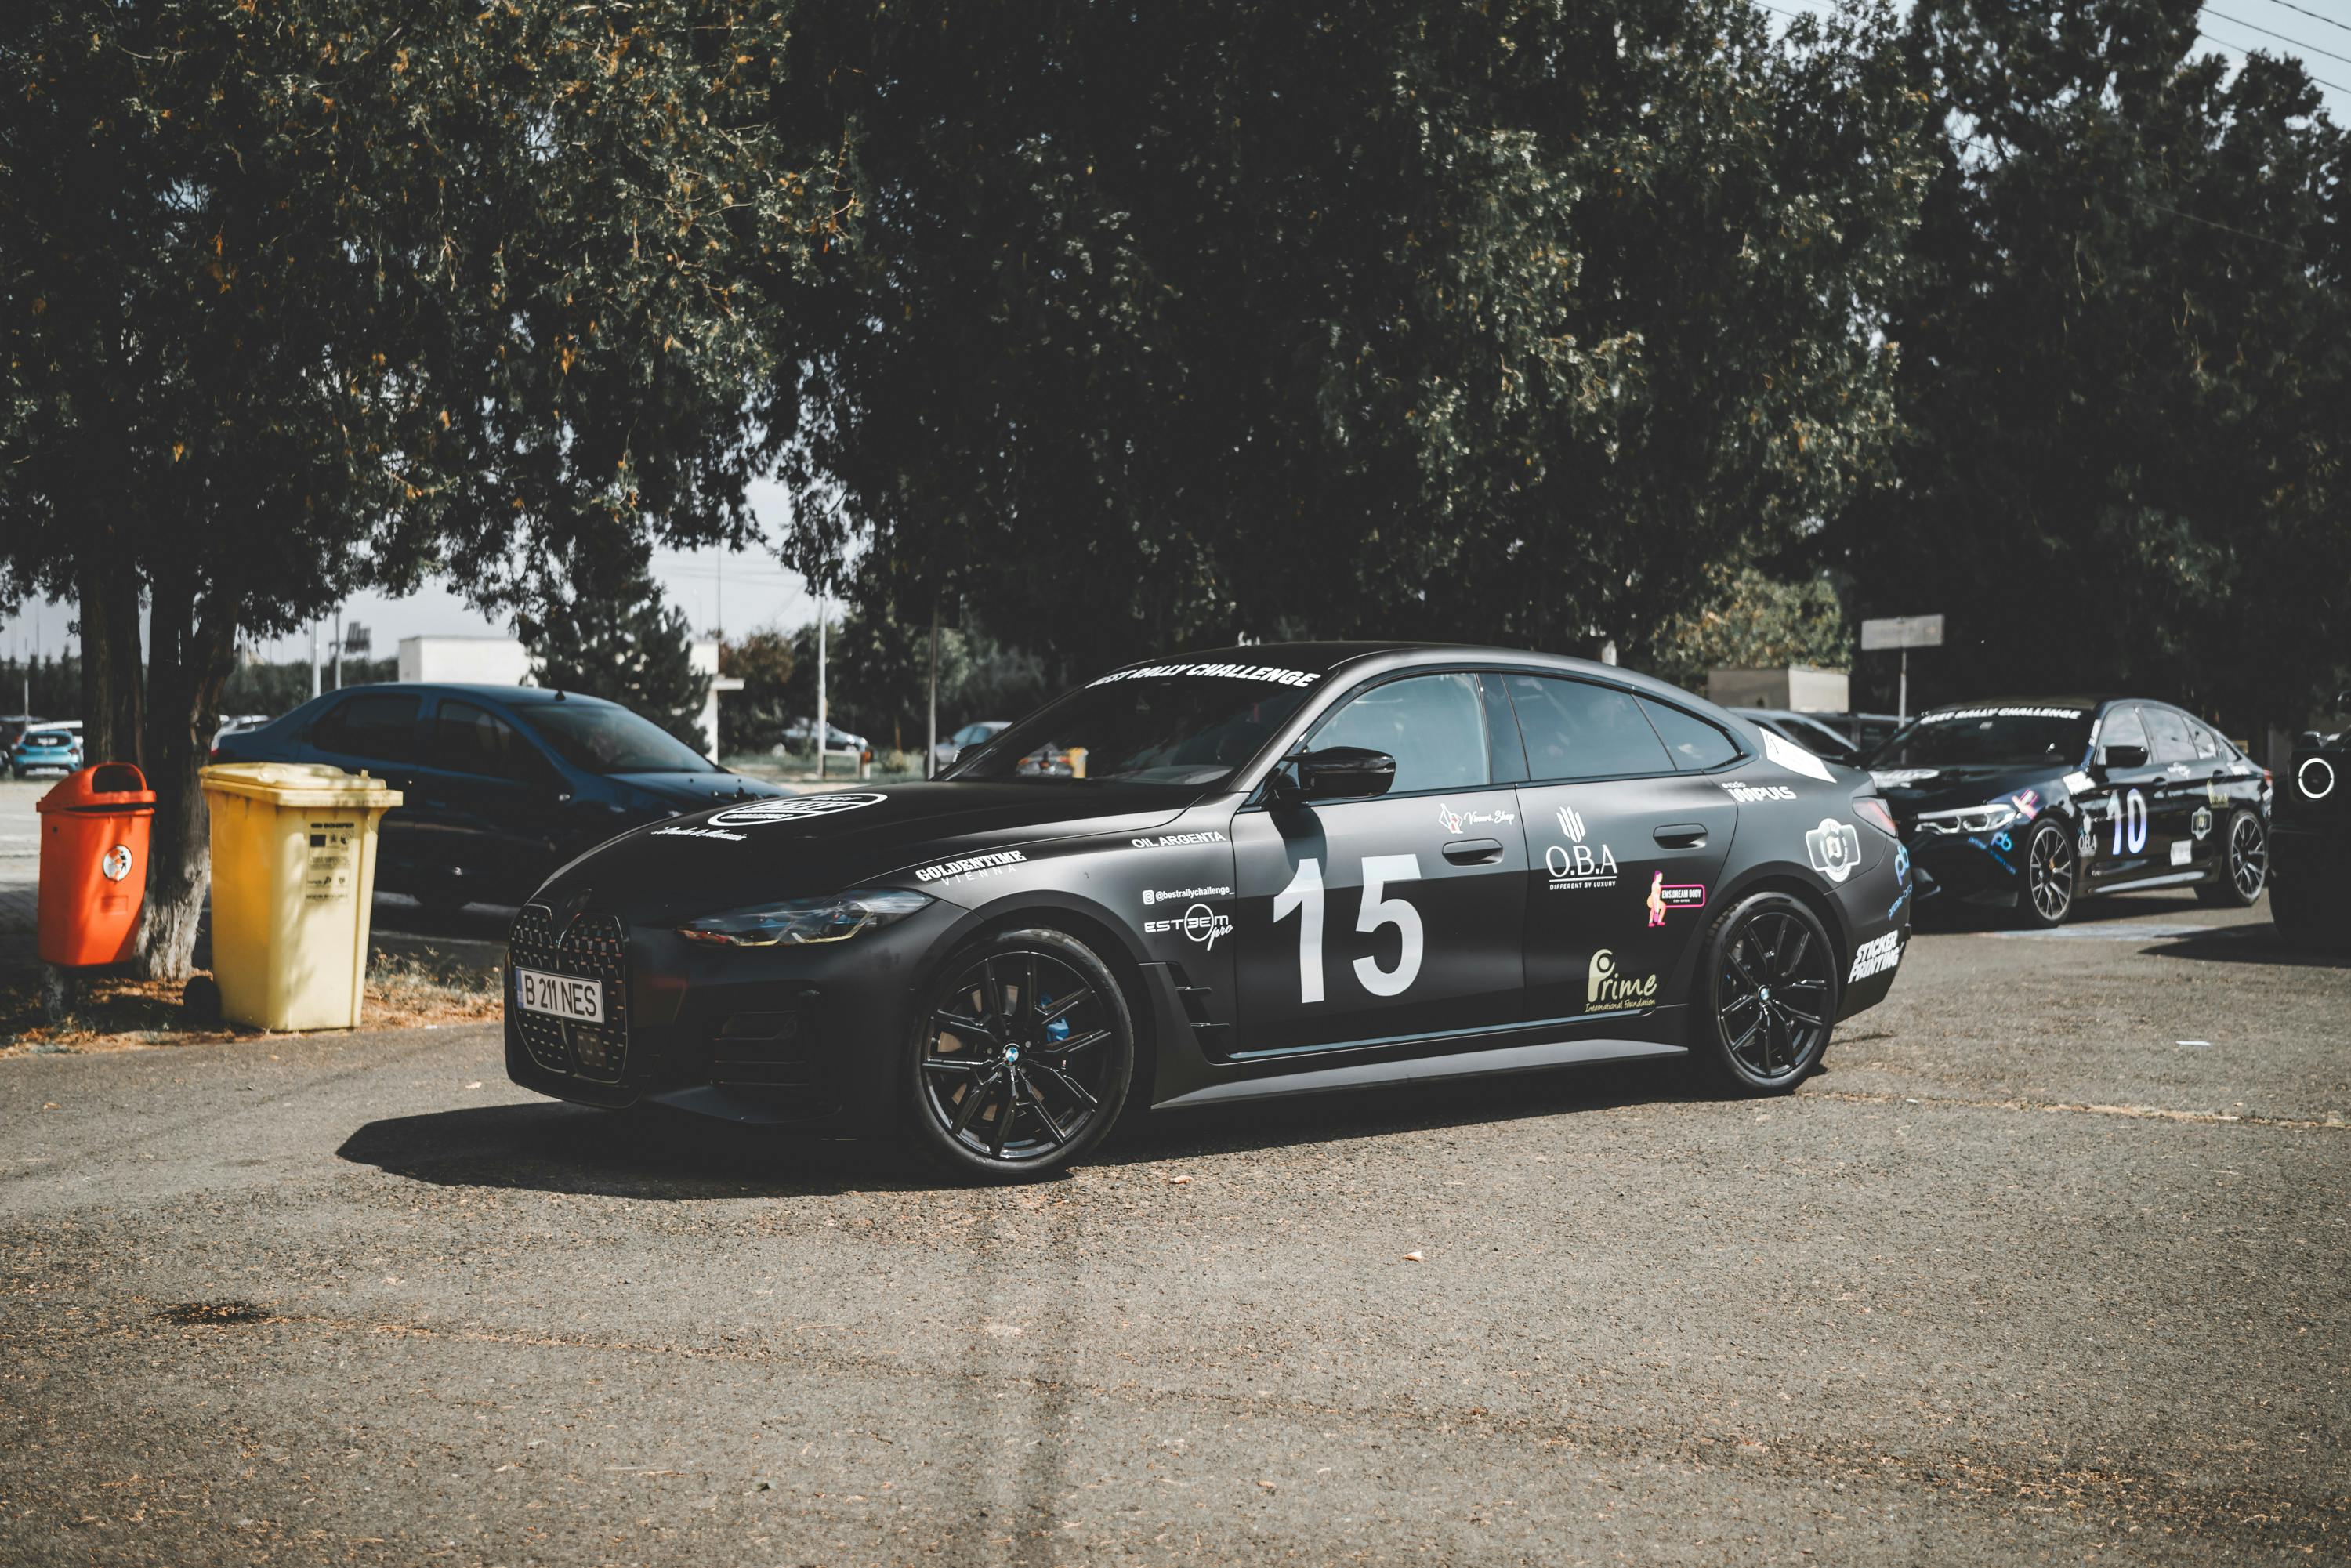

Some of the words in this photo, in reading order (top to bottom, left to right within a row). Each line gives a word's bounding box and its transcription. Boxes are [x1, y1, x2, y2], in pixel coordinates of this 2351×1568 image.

[1127, 664, 1195, 679] RALLY
[1186, 664, 1321, 687] CHALLENGE
[2106, 788, 2147, 855] 10
[1131, 838, 1159, 848] OIL
[1158, 831, 1226, 846] ARGENTA
[915, 850, 1027, 882] GOLDENTIME
[941, 864, 1016, 887] VIENNA
[1545, 844, 1618, 878] O.B.A
[1155, 885, 1236, 902] @bestrallychallenge_
[1549, 882, 1582, 891] DIFFERENT
[1273, 853, 1424, 1004] 15
[1853, 929, 1899, 965] STICKER
[1587, 948, 1657, 1003] Prime
[1847, 946, 1900, 984] PRINTING
[524, 974, 535, 1005] B
[538, 977, 558, 1010] 211
[560, 981, 597, 1017] NES
[1585, 1000, 1623, 1012] International
[1624, 998, 1656, 1009] Foundation
